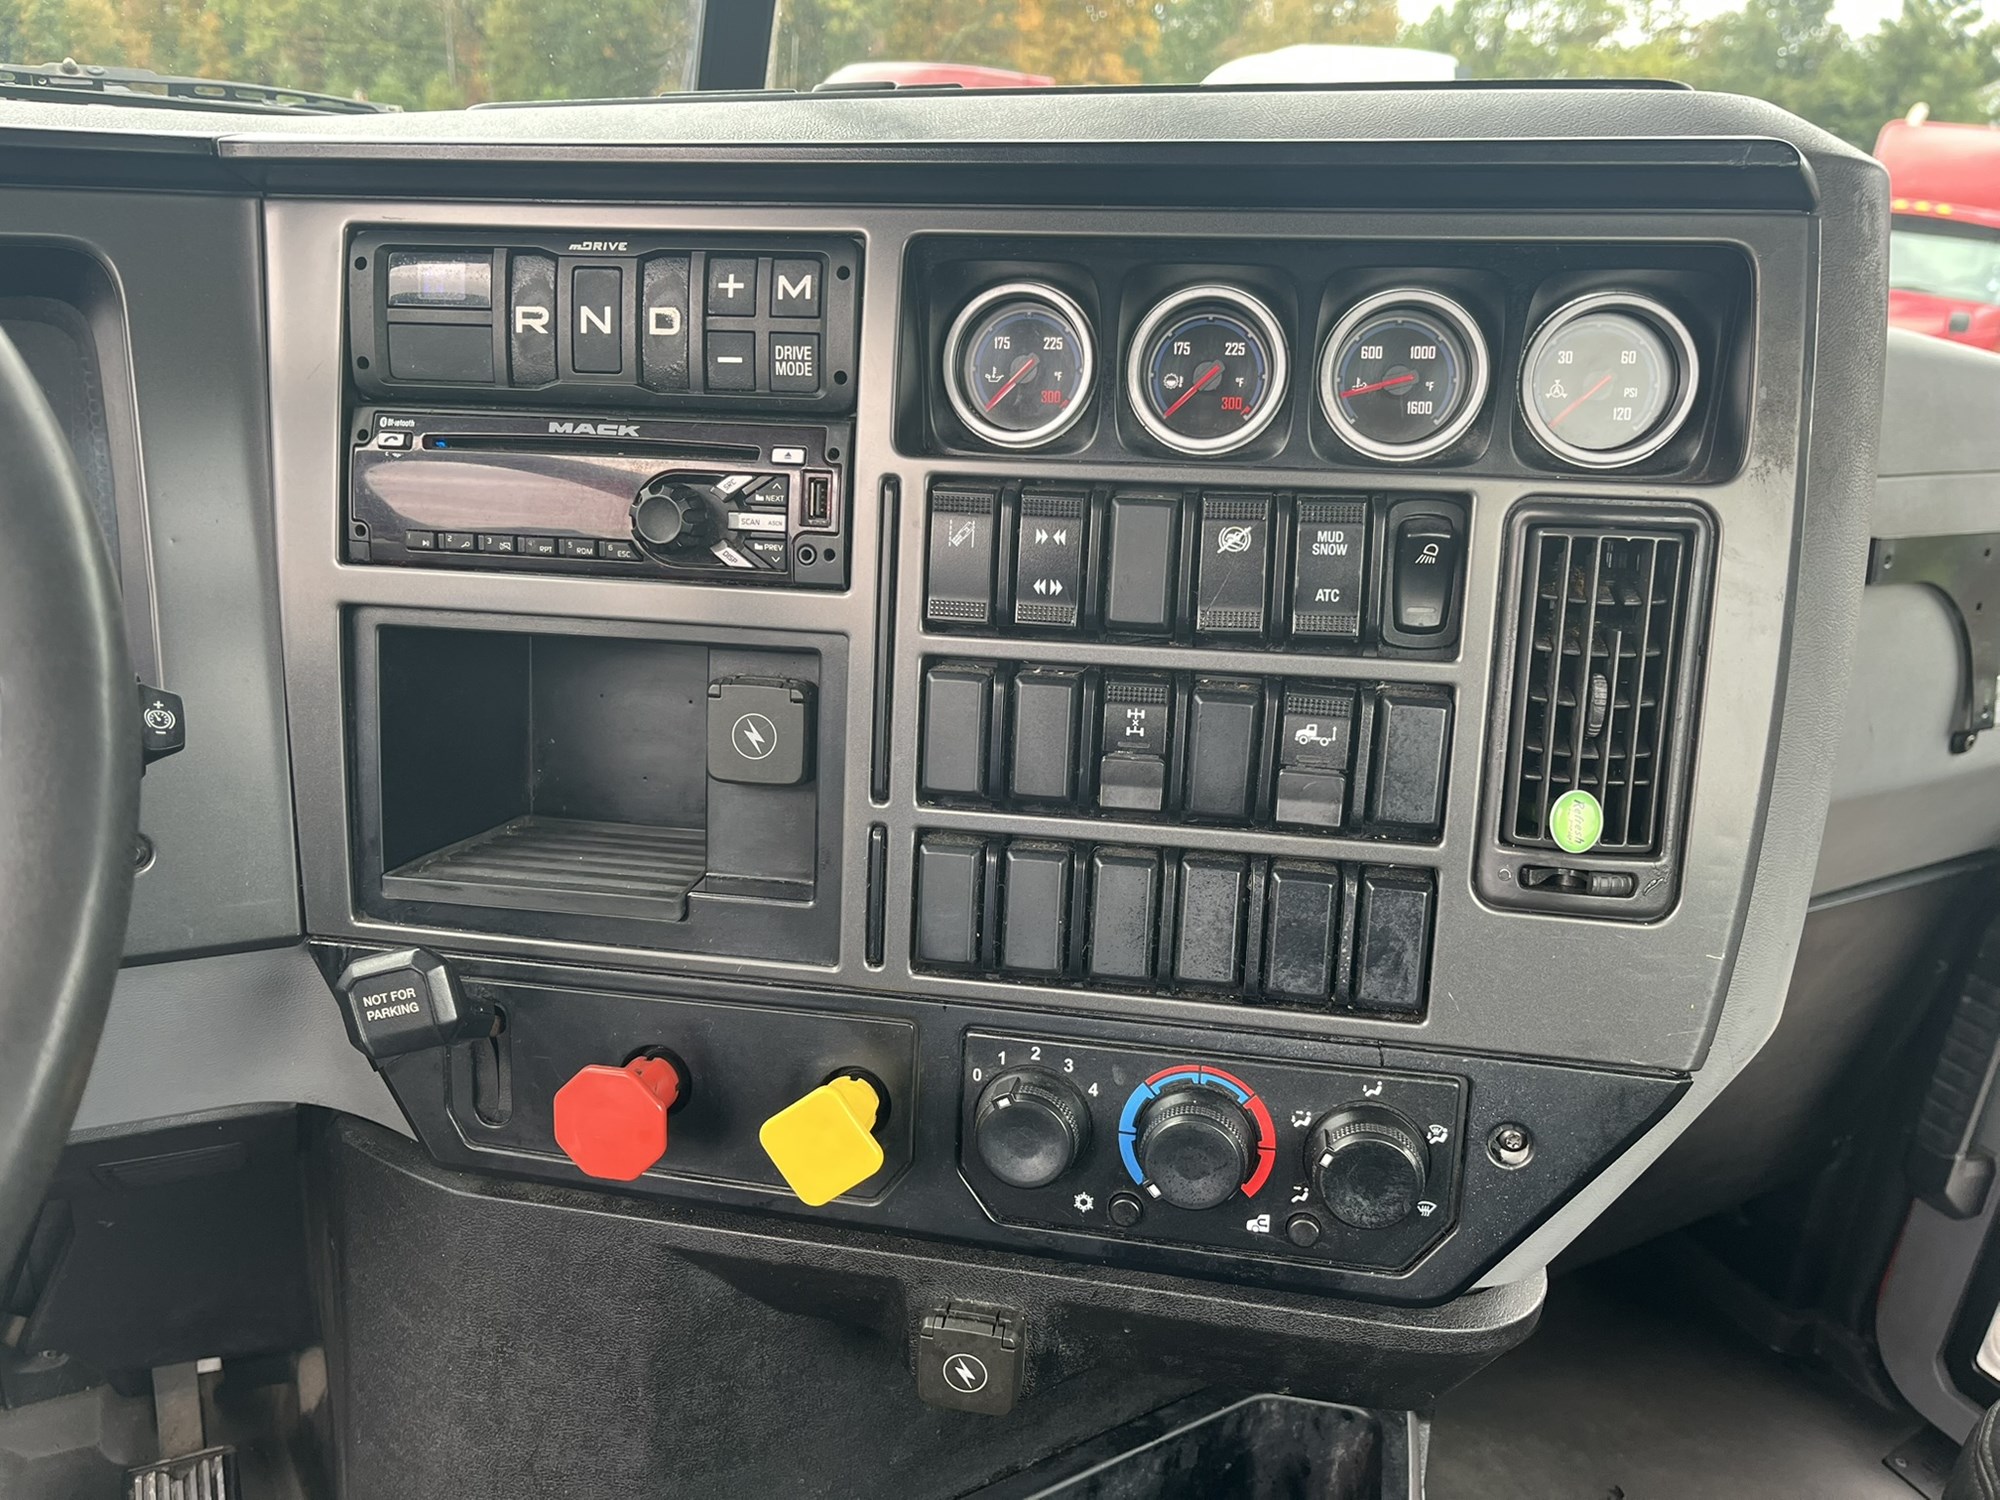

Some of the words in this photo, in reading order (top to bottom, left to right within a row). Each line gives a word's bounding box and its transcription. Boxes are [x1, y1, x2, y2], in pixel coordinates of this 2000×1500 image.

[778, 275, 812, 300] M
[515, 306, 549, 334] R
[580, 306, 611, 334] N
[649, 307, 681, 335] D
[994, 336, 1011, 350] 175
[1043, 337, 1063, 350] 225
[1173, 342, 1191, 355] 175
[1225, 342, 1246, 356] 225
[775, 345, 812, 360] DRIVE
[1361, 346, 1383, 359] 600
[1410, 346, 1436, 359] 1000
[1558, 351, 1573, 364] 30
[1621, 351, 1637, 364] 60
[775, 361, 812, 376] MODE
[1041, 390, 1062, 404] 300
[1624, 387, 1638, 398] PSI
[1221, 397, 1242, 410] 300
[1407, 401, 1433, 414] 1600
[1613, 407, 1632, 421] 120
[548, 422, 640, 437] MACK
[765, 494, 784, 502] NEXT
[741, 518, 760, 526] SCAN
[1317, 531, 1344, 542] MUD
[540, 545, 552, 553] RPT
[576, 547, 593, 555] RDM
[617, 550, 631, 558] ESC
[764, 543, 784, 552] PREV
[1311, 543, 1348, 556] SNOW
[1315, 588, 1340, 602] ATC
[1573, 799, 1585, 844] Refresh
[363, 993, 388, 1008] NOT
[390, 987, 416, 1002] FOR
[366, 1002, 420, 1021] PARKING
[998, 1051, 1006, 1065] 1
[1030, 1046, 1041, 1061] 2
[1063, 1058, 1074, 1073] 3
[972, 1068, 982, 1082] 0
[1088, 1082, 1099, 1097] 4
